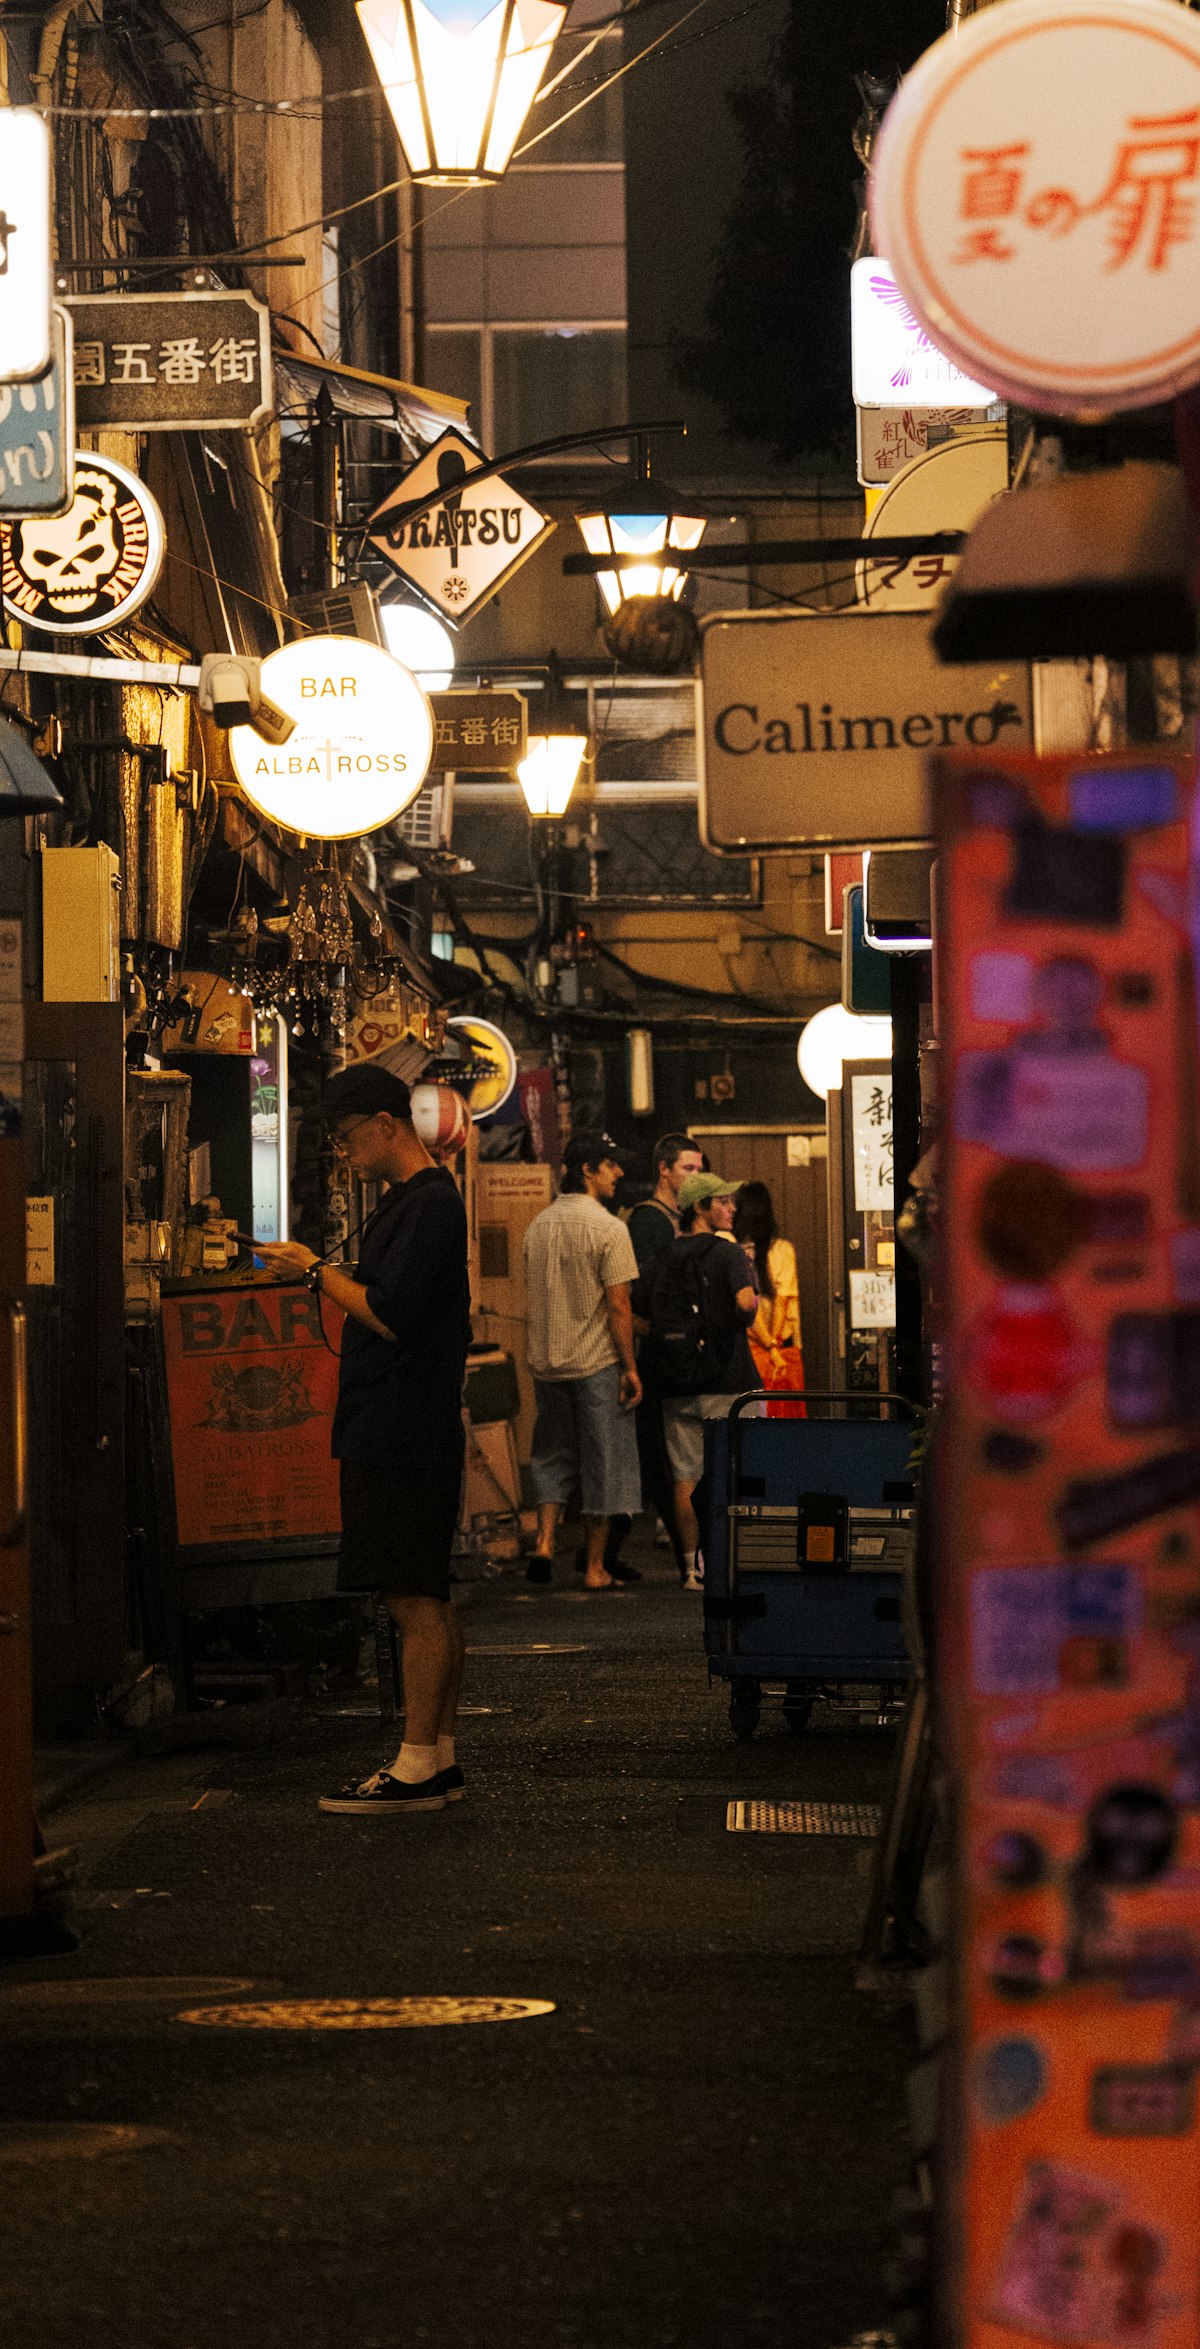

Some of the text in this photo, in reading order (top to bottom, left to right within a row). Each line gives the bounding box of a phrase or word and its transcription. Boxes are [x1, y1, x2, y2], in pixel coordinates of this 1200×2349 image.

[951, 110, 1200, 272] 夏の扉
[75, 337, 257, 386] 園五番街
[100, 500, 148, 606] DRUNK
[301, 677, 357, 698] BAR
[436, 717, 519, 746] 五番街
[713, 703, 1004, 756] Calimero
[180, 1294, 324, 1351] BAR
